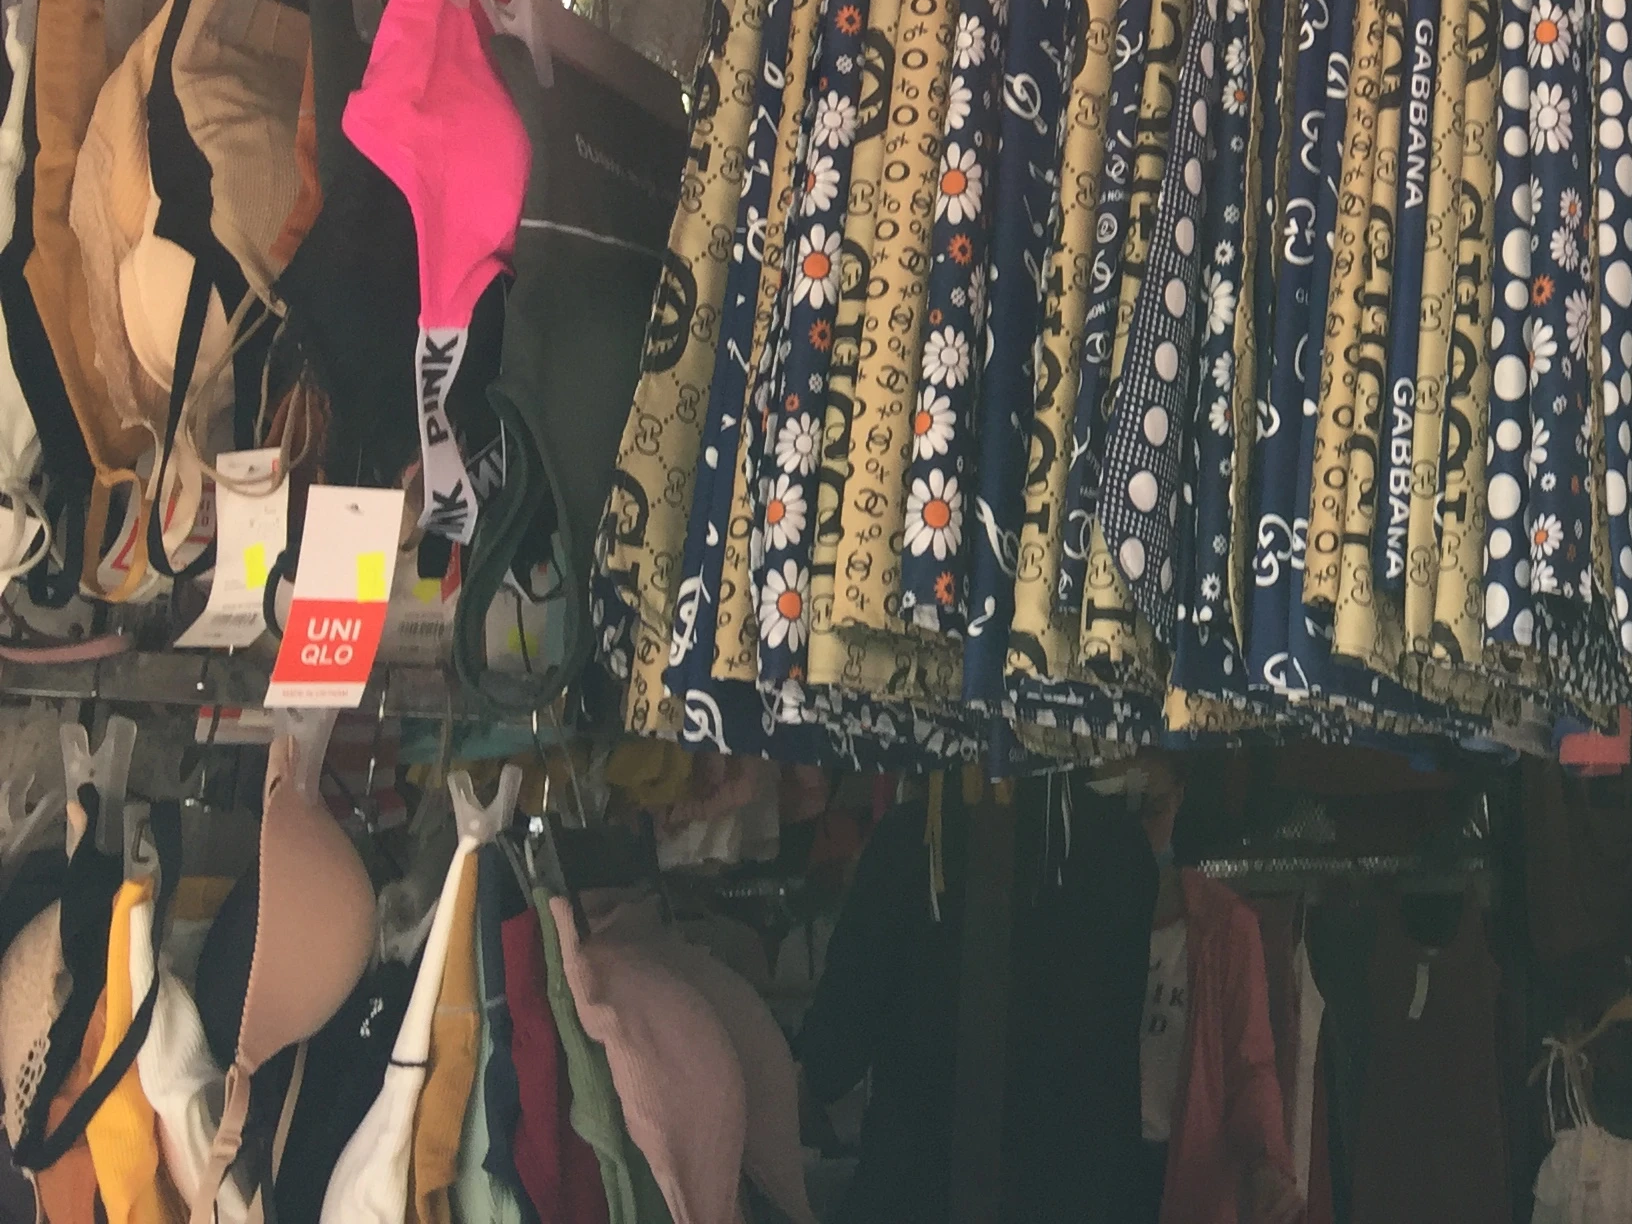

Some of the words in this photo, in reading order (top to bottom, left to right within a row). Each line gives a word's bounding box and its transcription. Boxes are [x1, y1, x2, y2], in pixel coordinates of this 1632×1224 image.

[1405, 18, 1433, 209] GABBANA
[422, 335, 459, 446] PINK
[1386, 377, 1414, 579] GABBANA
[301, 644, 353, 665] QLO
[307, 618, 361, 641] UNI
